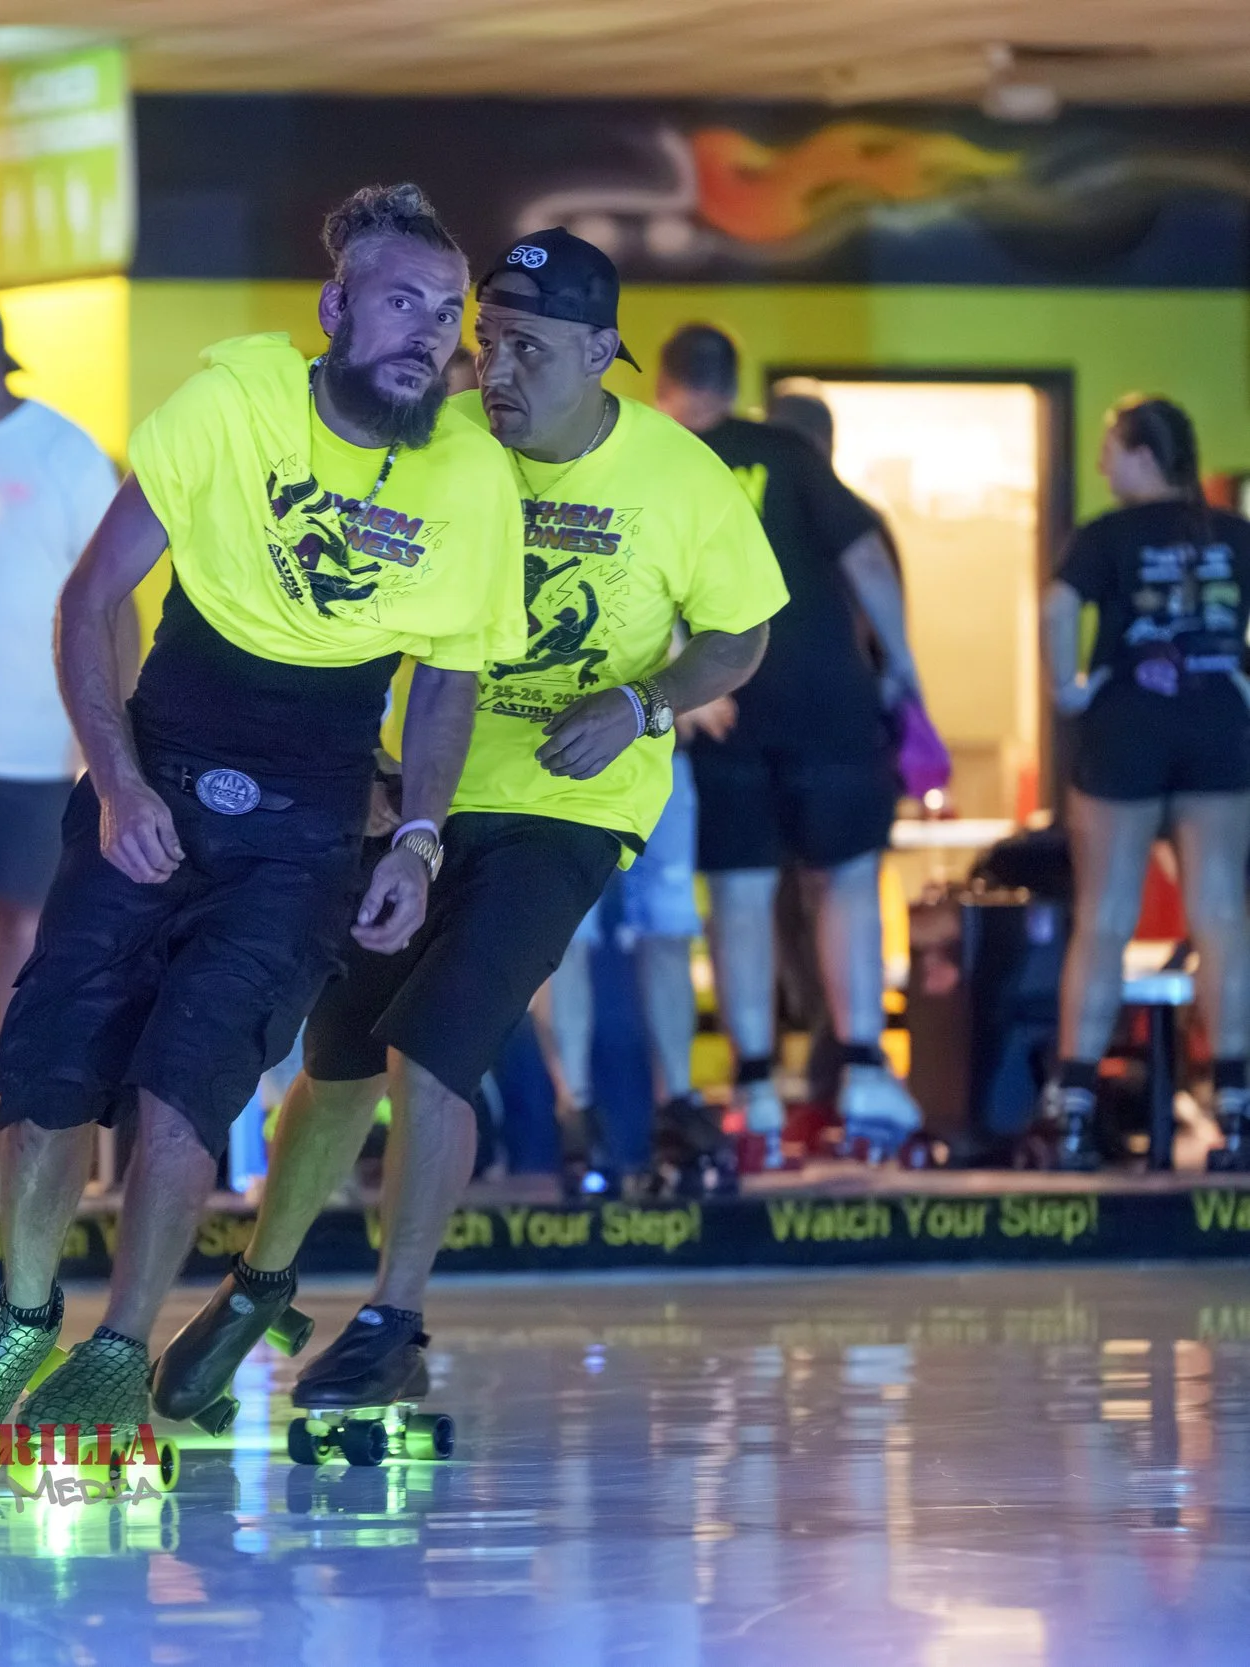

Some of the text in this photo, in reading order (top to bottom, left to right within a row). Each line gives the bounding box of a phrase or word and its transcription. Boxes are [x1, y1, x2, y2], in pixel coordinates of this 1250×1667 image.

[340, 522, 425, 567] NESS
[524, 524, 622, 556] DNESS
[504, 1204, 592, 1247] Your
[602, 1202, 702, 1251] Step!
[768, 1192, 1098, 1244] Watch Your Step!
